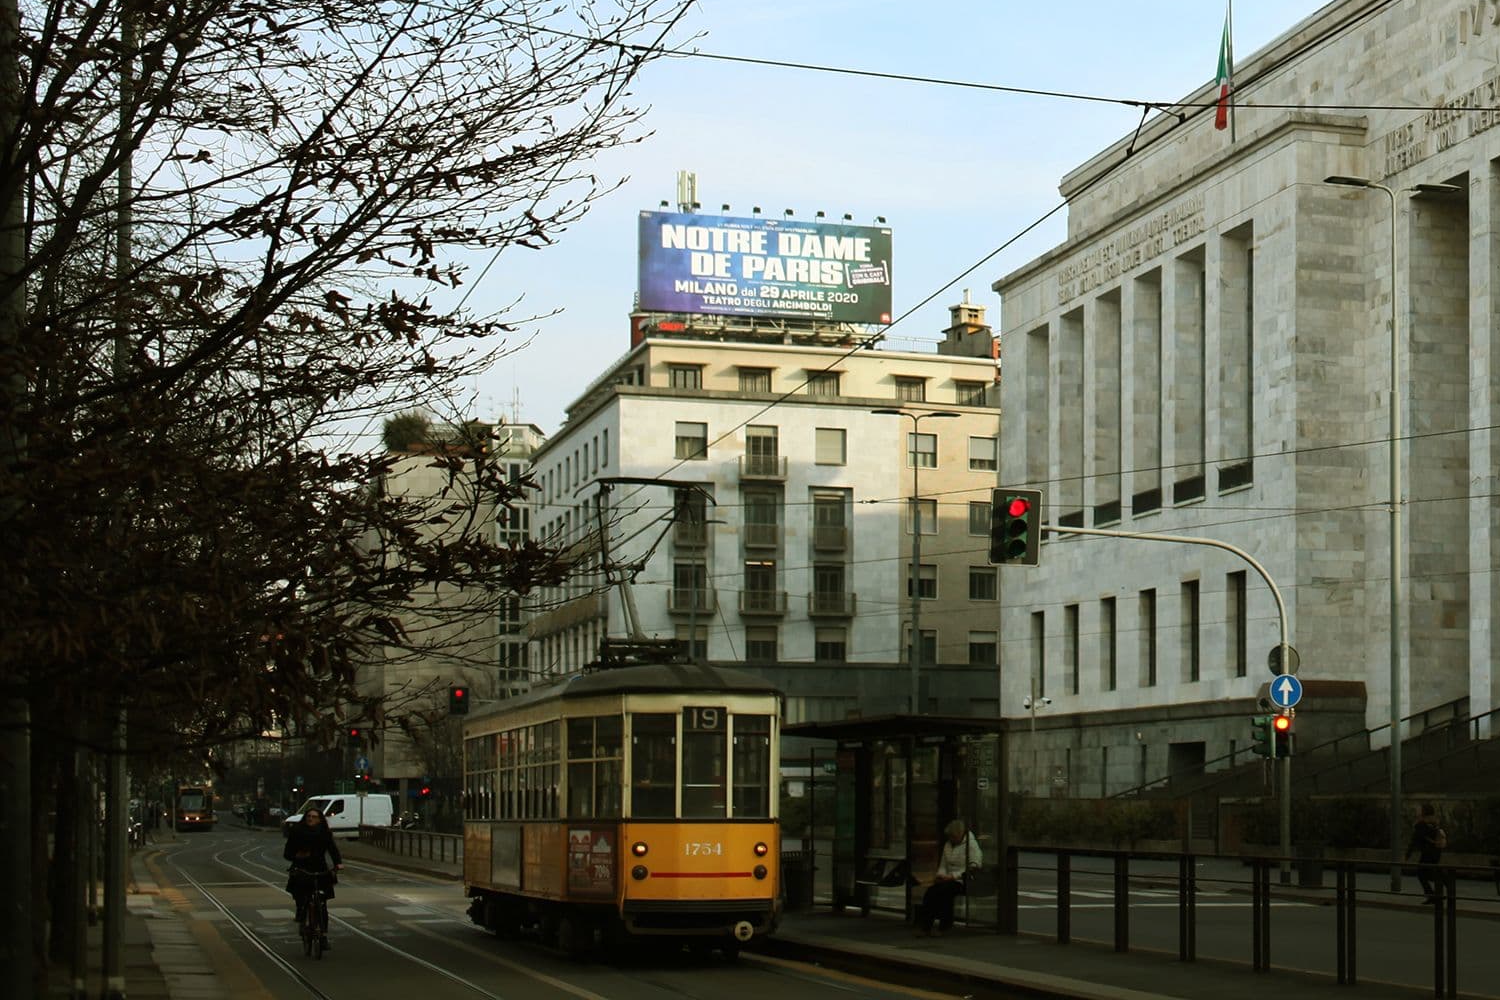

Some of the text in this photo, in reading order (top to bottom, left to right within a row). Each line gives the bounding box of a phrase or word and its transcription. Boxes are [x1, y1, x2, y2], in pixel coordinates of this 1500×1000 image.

[661, 224, 870, 262] NOTRE DAME
[691, 252, 843, 285] DE PARIS
[675, 280, 737, 296] MILANO
[741, 287, 756, 297] dal
[760, 285, 780, 299] 29
[782, 289, 825, 301] APRILE
[827, 291, 858, 303] 2020
[703, 295, 832, 311] TEATRO DEGLI ARCIMBOLDI
[693, 708, 718, 729] 19
[685, 842, 722, 856] 1754
